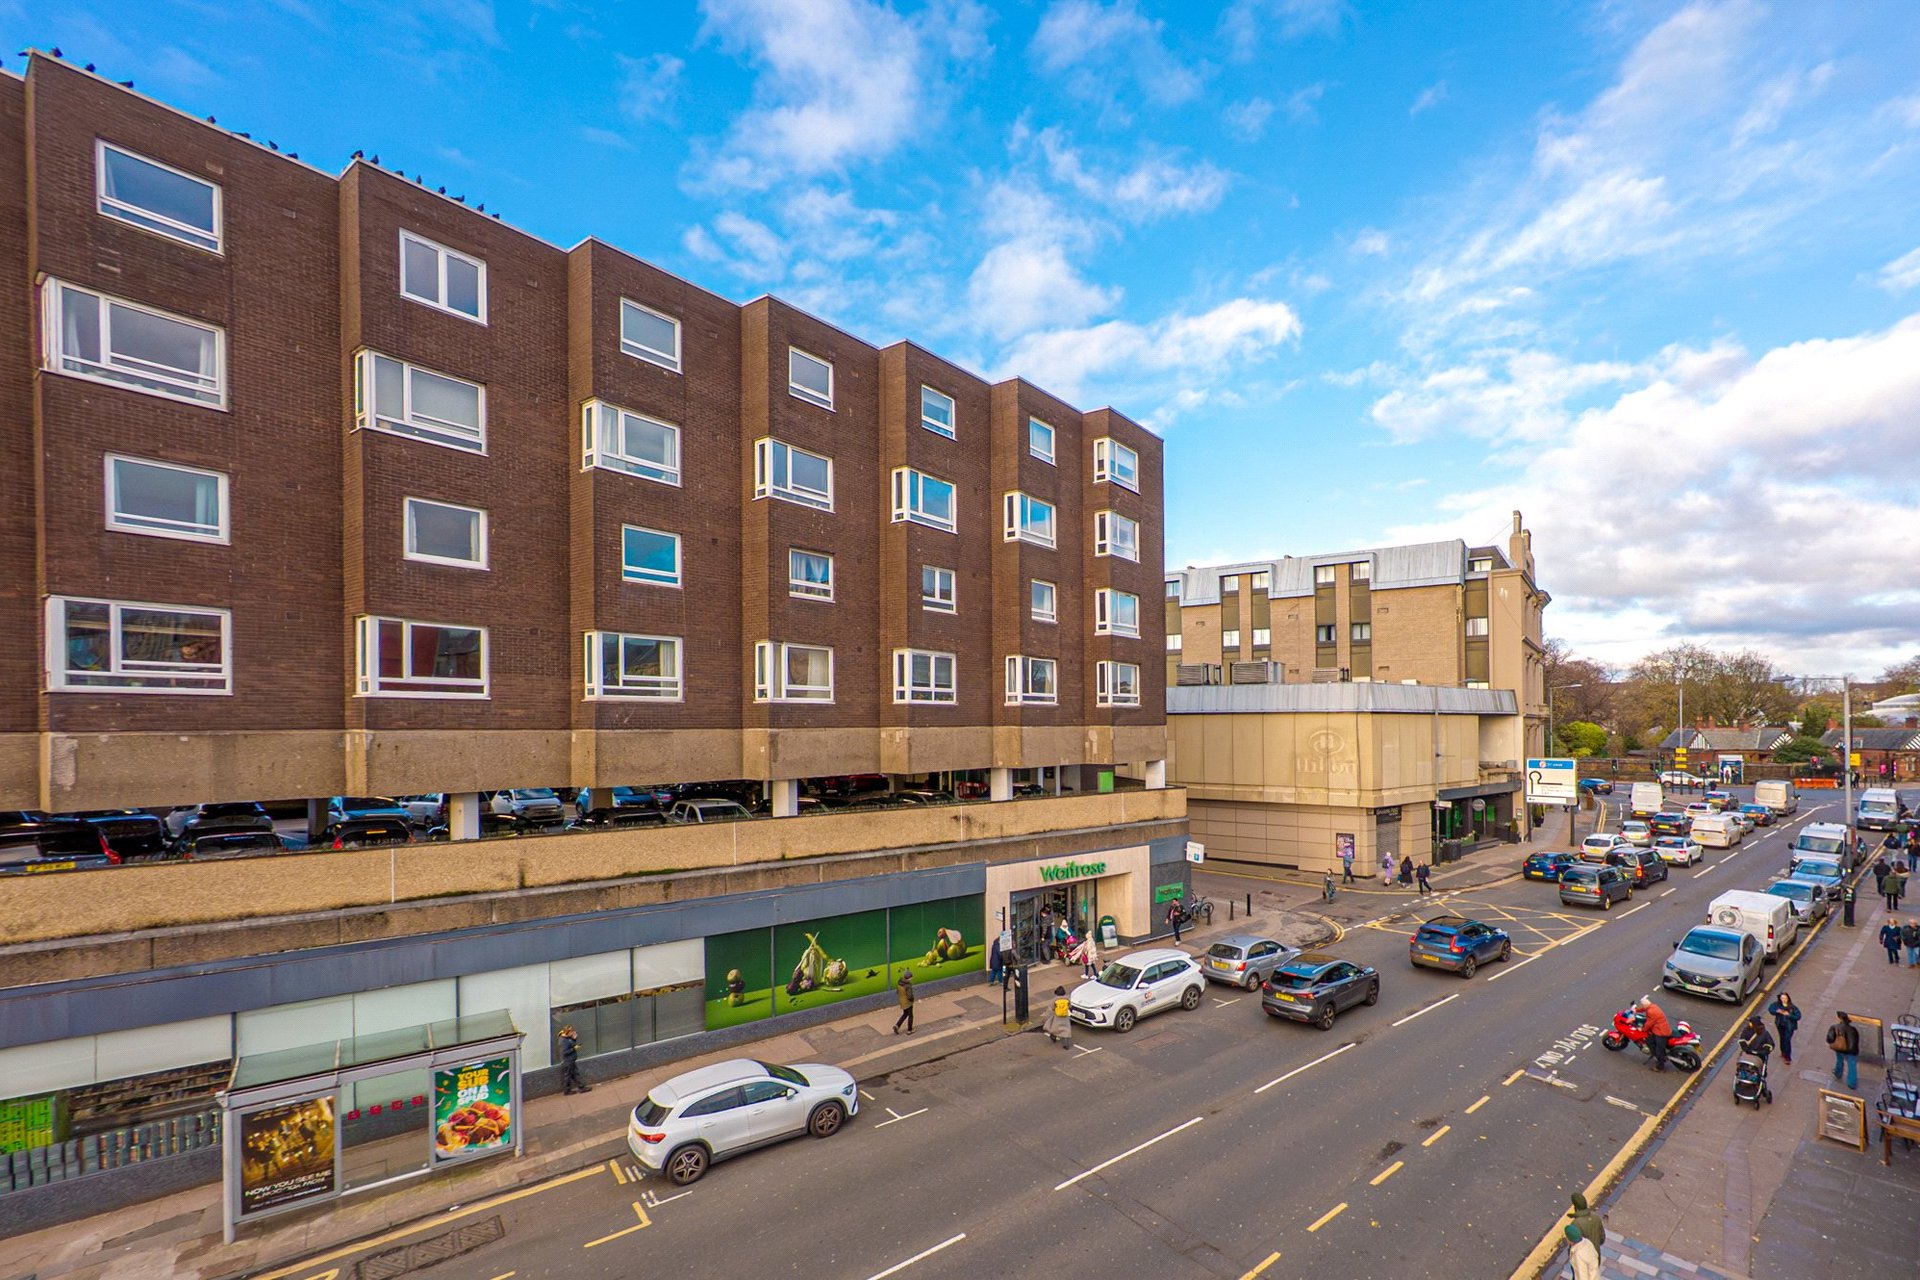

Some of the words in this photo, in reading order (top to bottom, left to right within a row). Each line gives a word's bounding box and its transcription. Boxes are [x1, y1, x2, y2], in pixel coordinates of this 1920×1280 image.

[1039, 860, 1107, 882] Waitrose
[1570, 1024, 1599, 1040] SOLO
[1534, 1050, 1564, 1068] ONLY
[457, 1068, 489, 1080] YOUR
[457, 1076, 489, 1090] SUB
[457, 1086, 478, 1098] ON
[478, 1084, 489, 1092] A
[245, 1185, 272, 1197] NOW
[274, 1179, 295, 1189] YOU
[295, 1174, 315, 1183] SEE
[315, 1169, 332, 1178] ME
